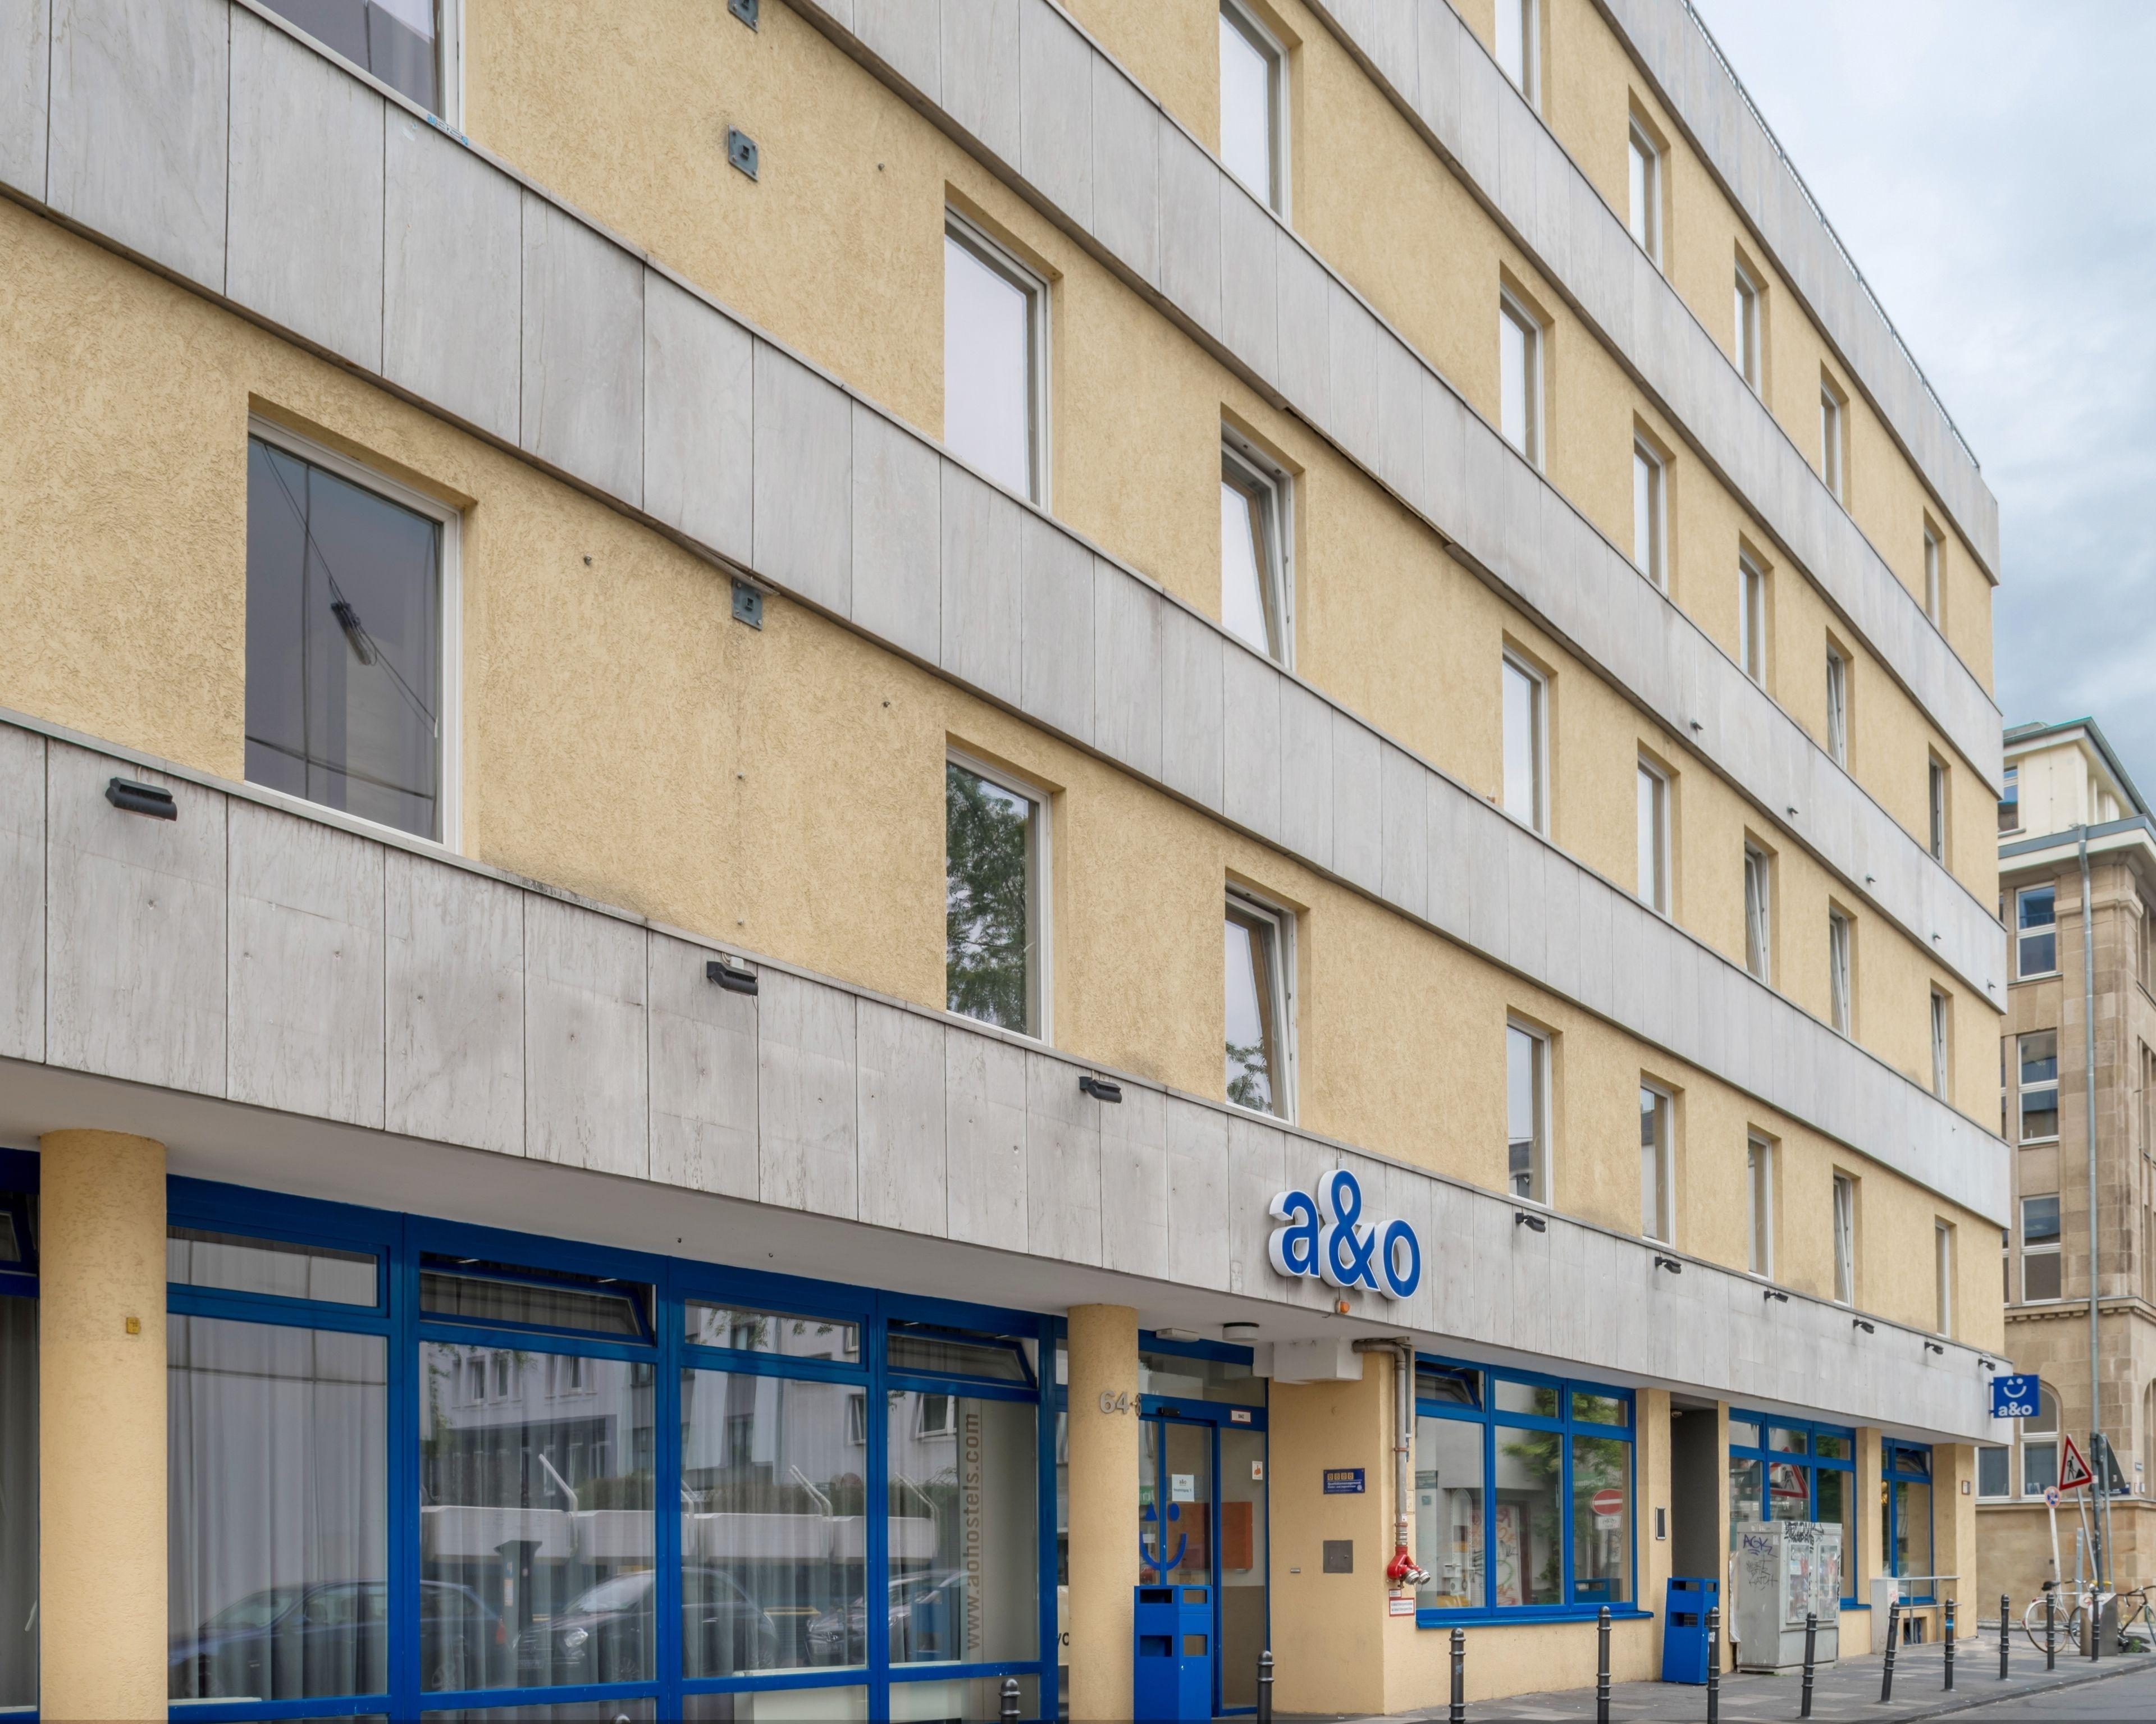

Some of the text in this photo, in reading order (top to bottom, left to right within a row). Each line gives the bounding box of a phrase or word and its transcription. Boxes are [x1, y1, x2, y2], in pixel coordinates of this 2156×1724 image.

[1269, 1170, 1420, 1300] a&o
[1998, 1402, 2032, 1416] a&o
[962, 1414, 980, 1650] www.aohostels.com
